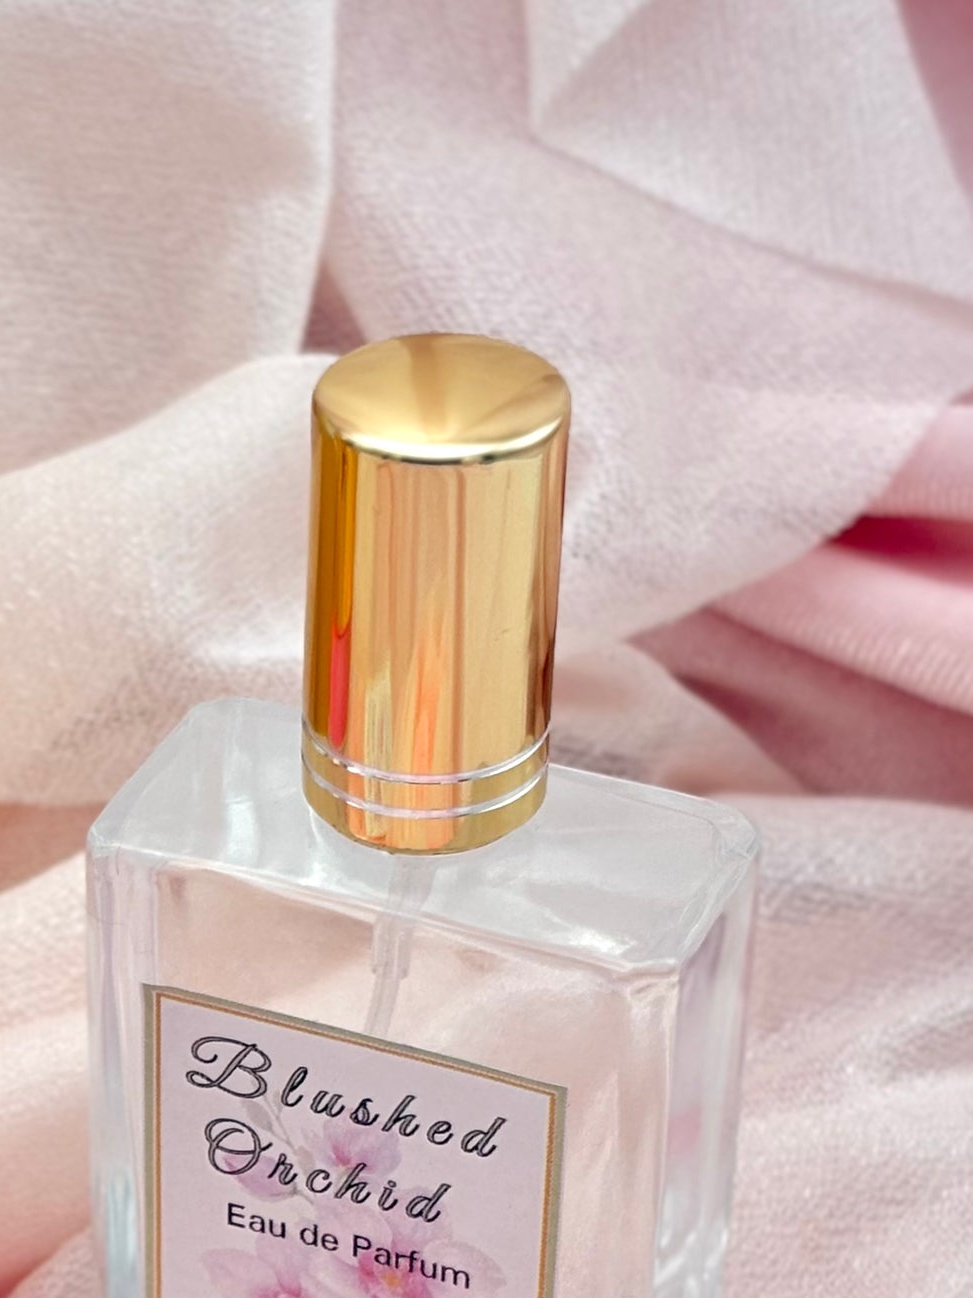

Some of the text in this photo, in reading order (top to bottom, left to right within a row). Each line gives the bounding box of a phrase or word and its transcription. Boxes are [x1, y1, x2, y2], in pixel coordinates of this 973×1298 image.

[185, 1035, 507, 1158] Blushed
[204, 1118, 452, 1224] Orchid
[226, 1202, 471, 1290] Eau de Parfum
